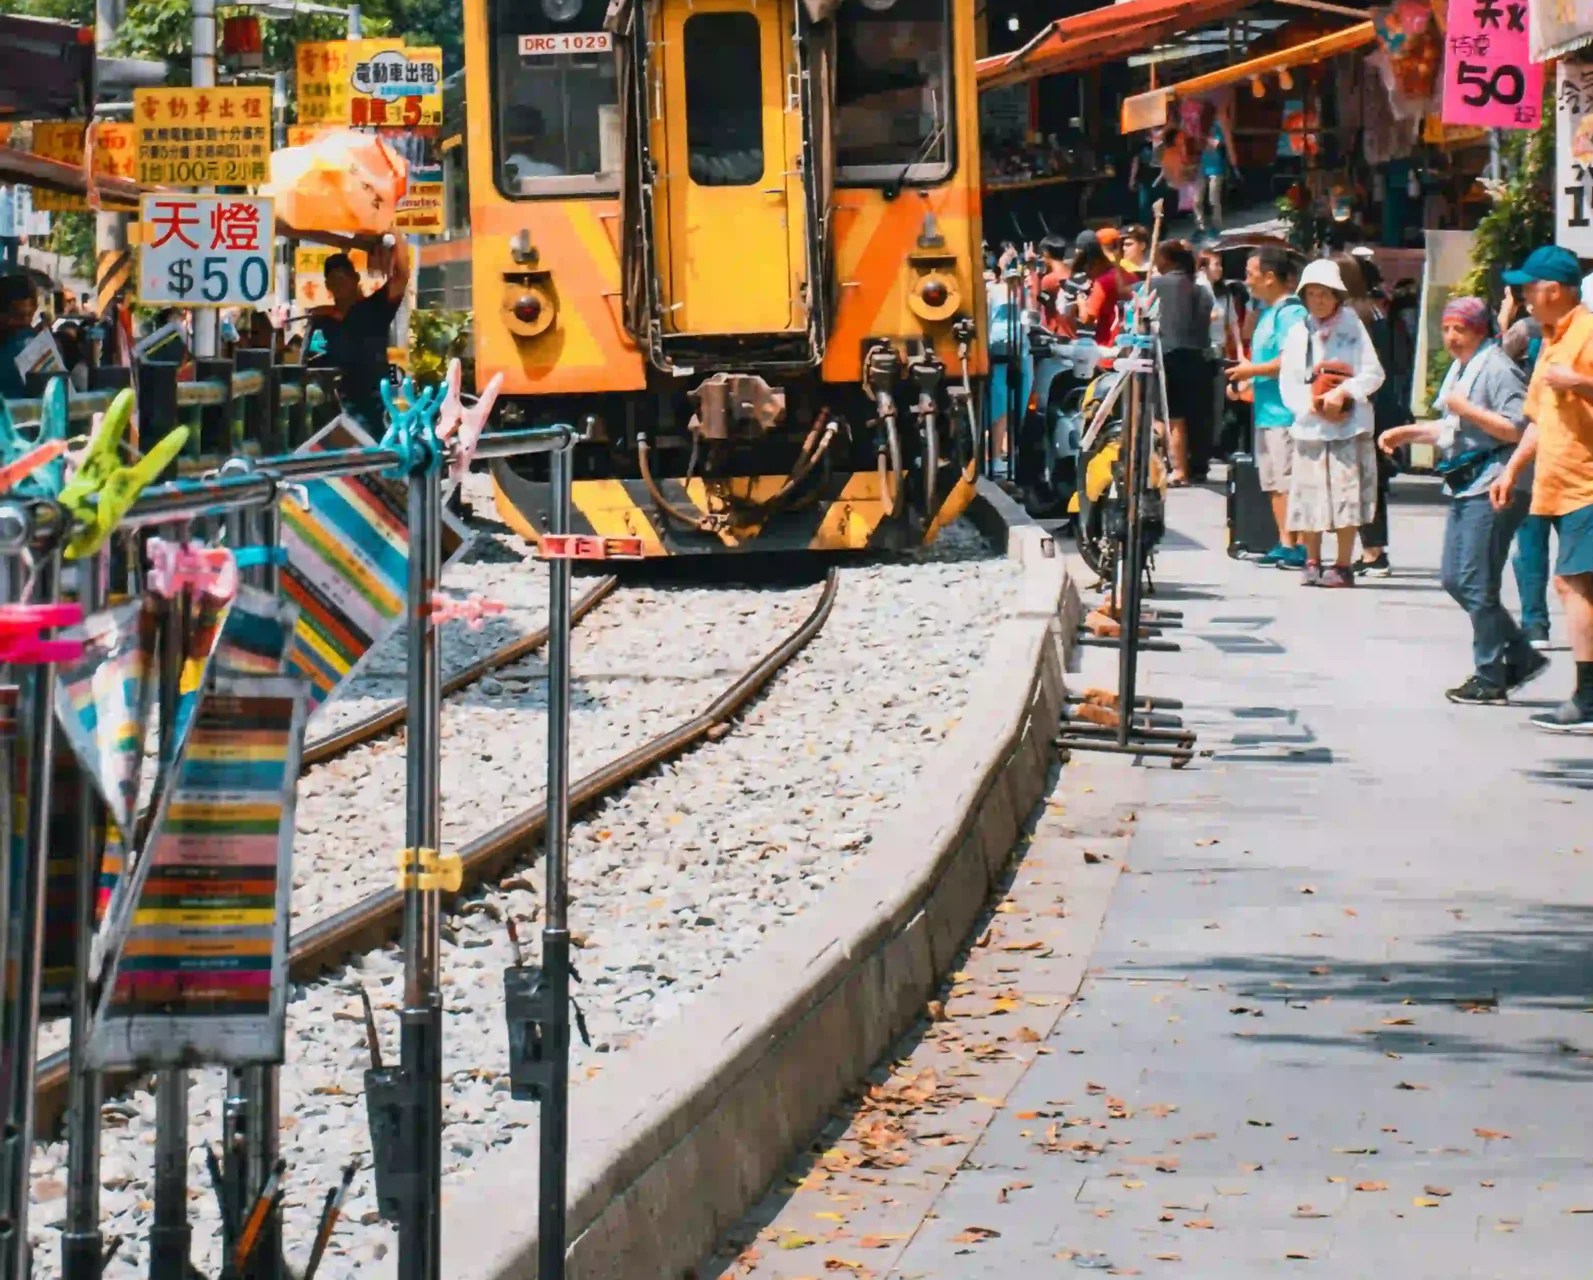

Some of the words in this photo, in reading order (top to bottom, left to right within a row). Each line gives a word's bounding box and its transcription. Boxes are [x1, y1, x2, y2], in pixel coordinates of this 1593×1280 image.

[524, 38, 556, 51] DRC
[562, 36, 608, 50] 1029
[355, 62, 436, 84] 電動車出租
[1456, 60, 1525, 107] 50
[140, 95, 263, 122] 電動車出租
[150, 202, 260, 250] 天燈
[167, 255, 269, 302] $50
